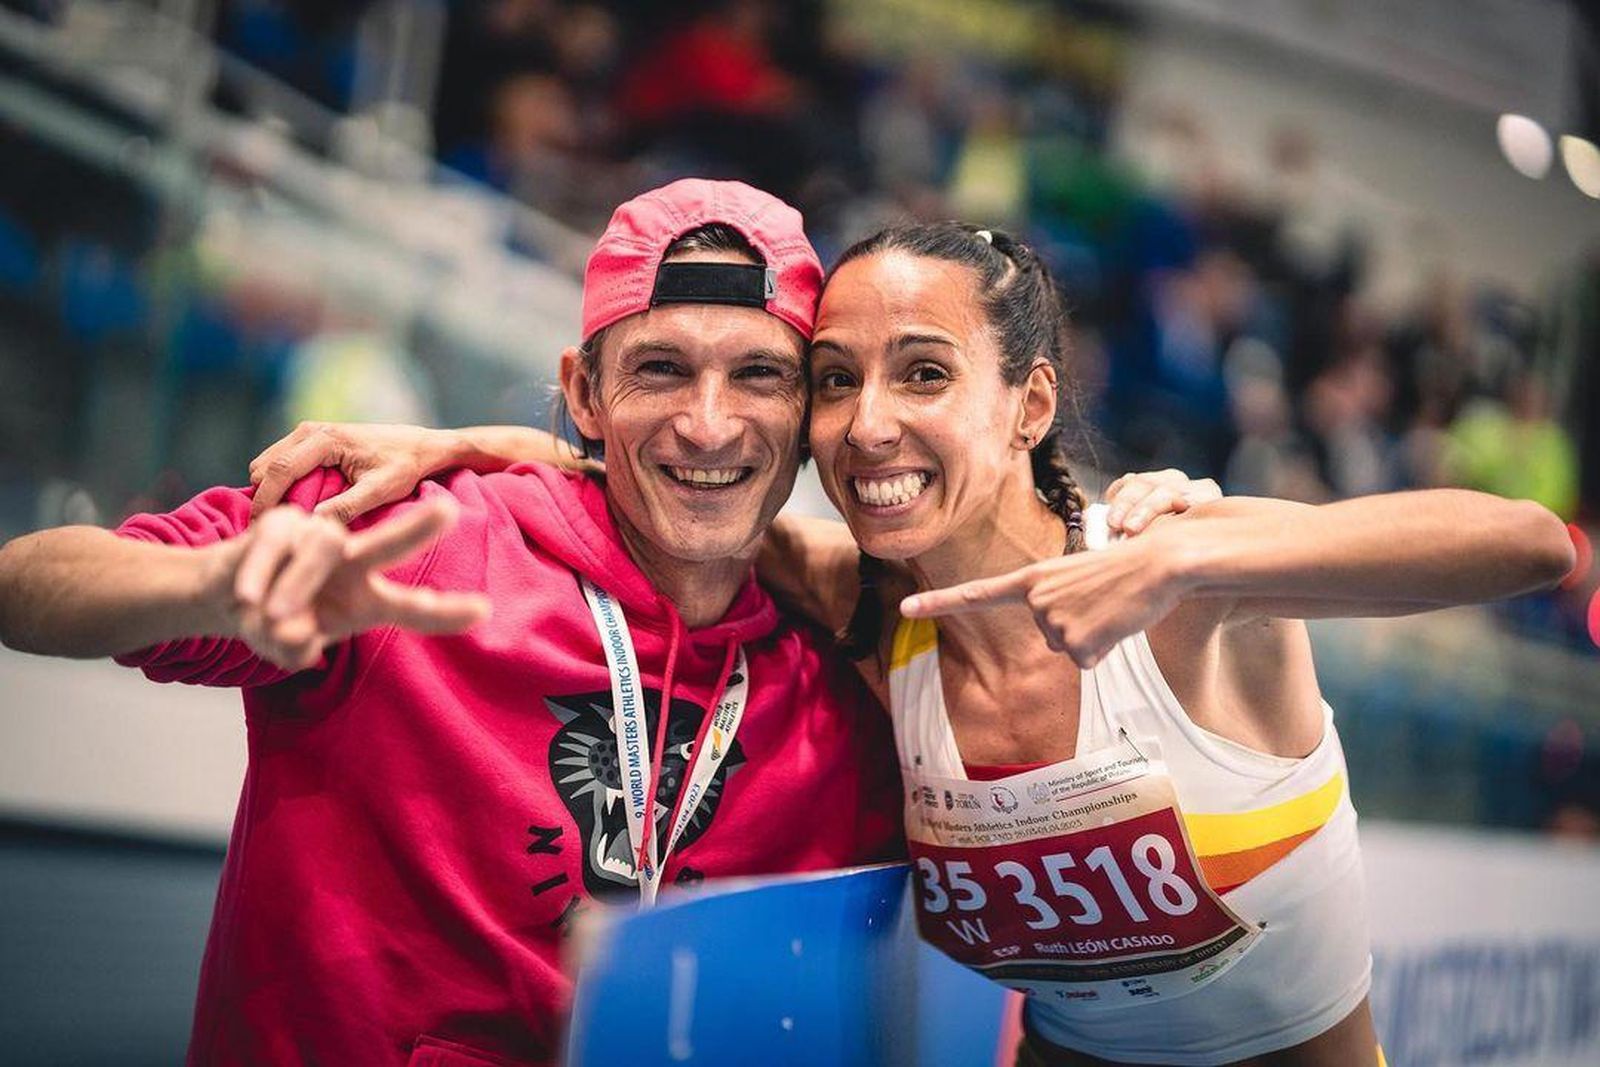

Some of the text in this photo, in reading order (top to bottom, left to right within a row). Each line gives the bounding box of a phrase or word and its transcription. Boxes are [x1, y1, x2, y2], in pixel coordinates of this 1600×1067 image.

[608, 630, 628, 666] INDOOR
[617, 666, 637, 719] ATHLETICS
[624, 719, 641, 768] MASTERS
[629, 769, 645, 808] WORLD
[1048, 774, 1075, 787] Ministry
[1076, 772, 1084, 781] of
[1084, 767, 1103, 779] Sport
[1104, 764, 1117, 772] and
[1060, 784, 1071, 794] the
[1071, 776, 1100, 791] Republic
[974, 820, 1014, 833] Athletics
[1015, 811, 1051, 827] Indoor
[1052, 791, 1139, 821] Championships
[916, 833, 1198, 931] 35 3518
[946, 917, 991, 946] W
[992, 934, 1176, 958] ESP Ruth LEÓN CASADO
